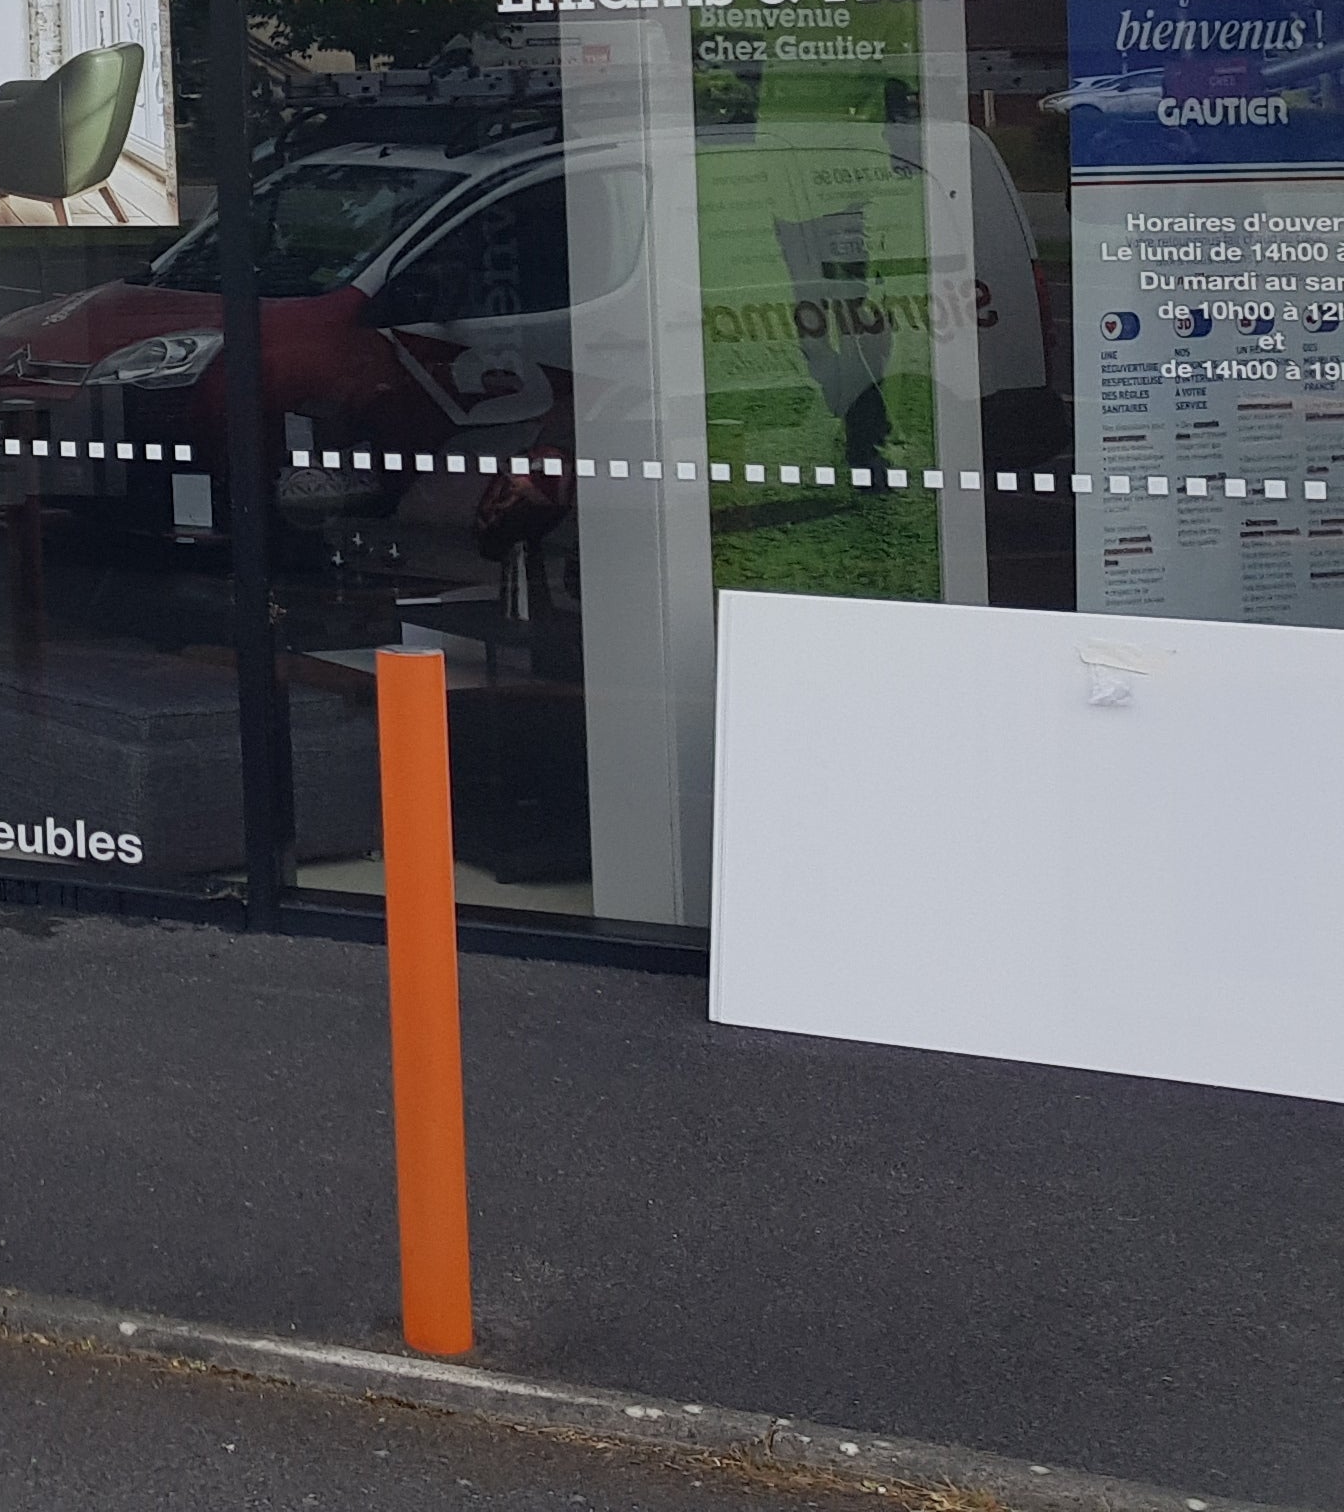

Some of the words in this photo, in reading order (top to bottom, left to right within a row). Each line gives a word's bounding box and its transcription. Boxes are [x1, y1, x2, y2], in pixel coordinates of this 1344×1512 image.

[699, 7, 852, 28] Bienvenue
[1115, 8, 1307, 52] bienvenus
[1314, 8, 1325, 50] !
[698, 35, 768, 61] chez
[774, 35, 886, 61] Gautier
[1157, 95, 1289, 128] GAUTIER
[1127, 212, 1236, 233] Horaires
[1101, 242, 1133, 262] Le
[1140, 242, 1202, 262] lundi
[1209, 242, 1242, 262] de
[1251, 242, 1329, 262] 14h00
[1140, 271, 1177, 291] Du
[1183, 271, 1257, 291] mardi
[1264, 275, 1297, 291] au
[1158, 301, 1190, 321] de
[1199, 301, 1275, 321] 10h00
[1282, 301, 1299, 321] à
[1258, 332, 1286, 350] et
[1161, 359, 1193, 379] de
[1203, 359, 1278, 380] 14h00
[1285, 360, 1301, 380] à
[1310, 361, 1344, 381] 19
